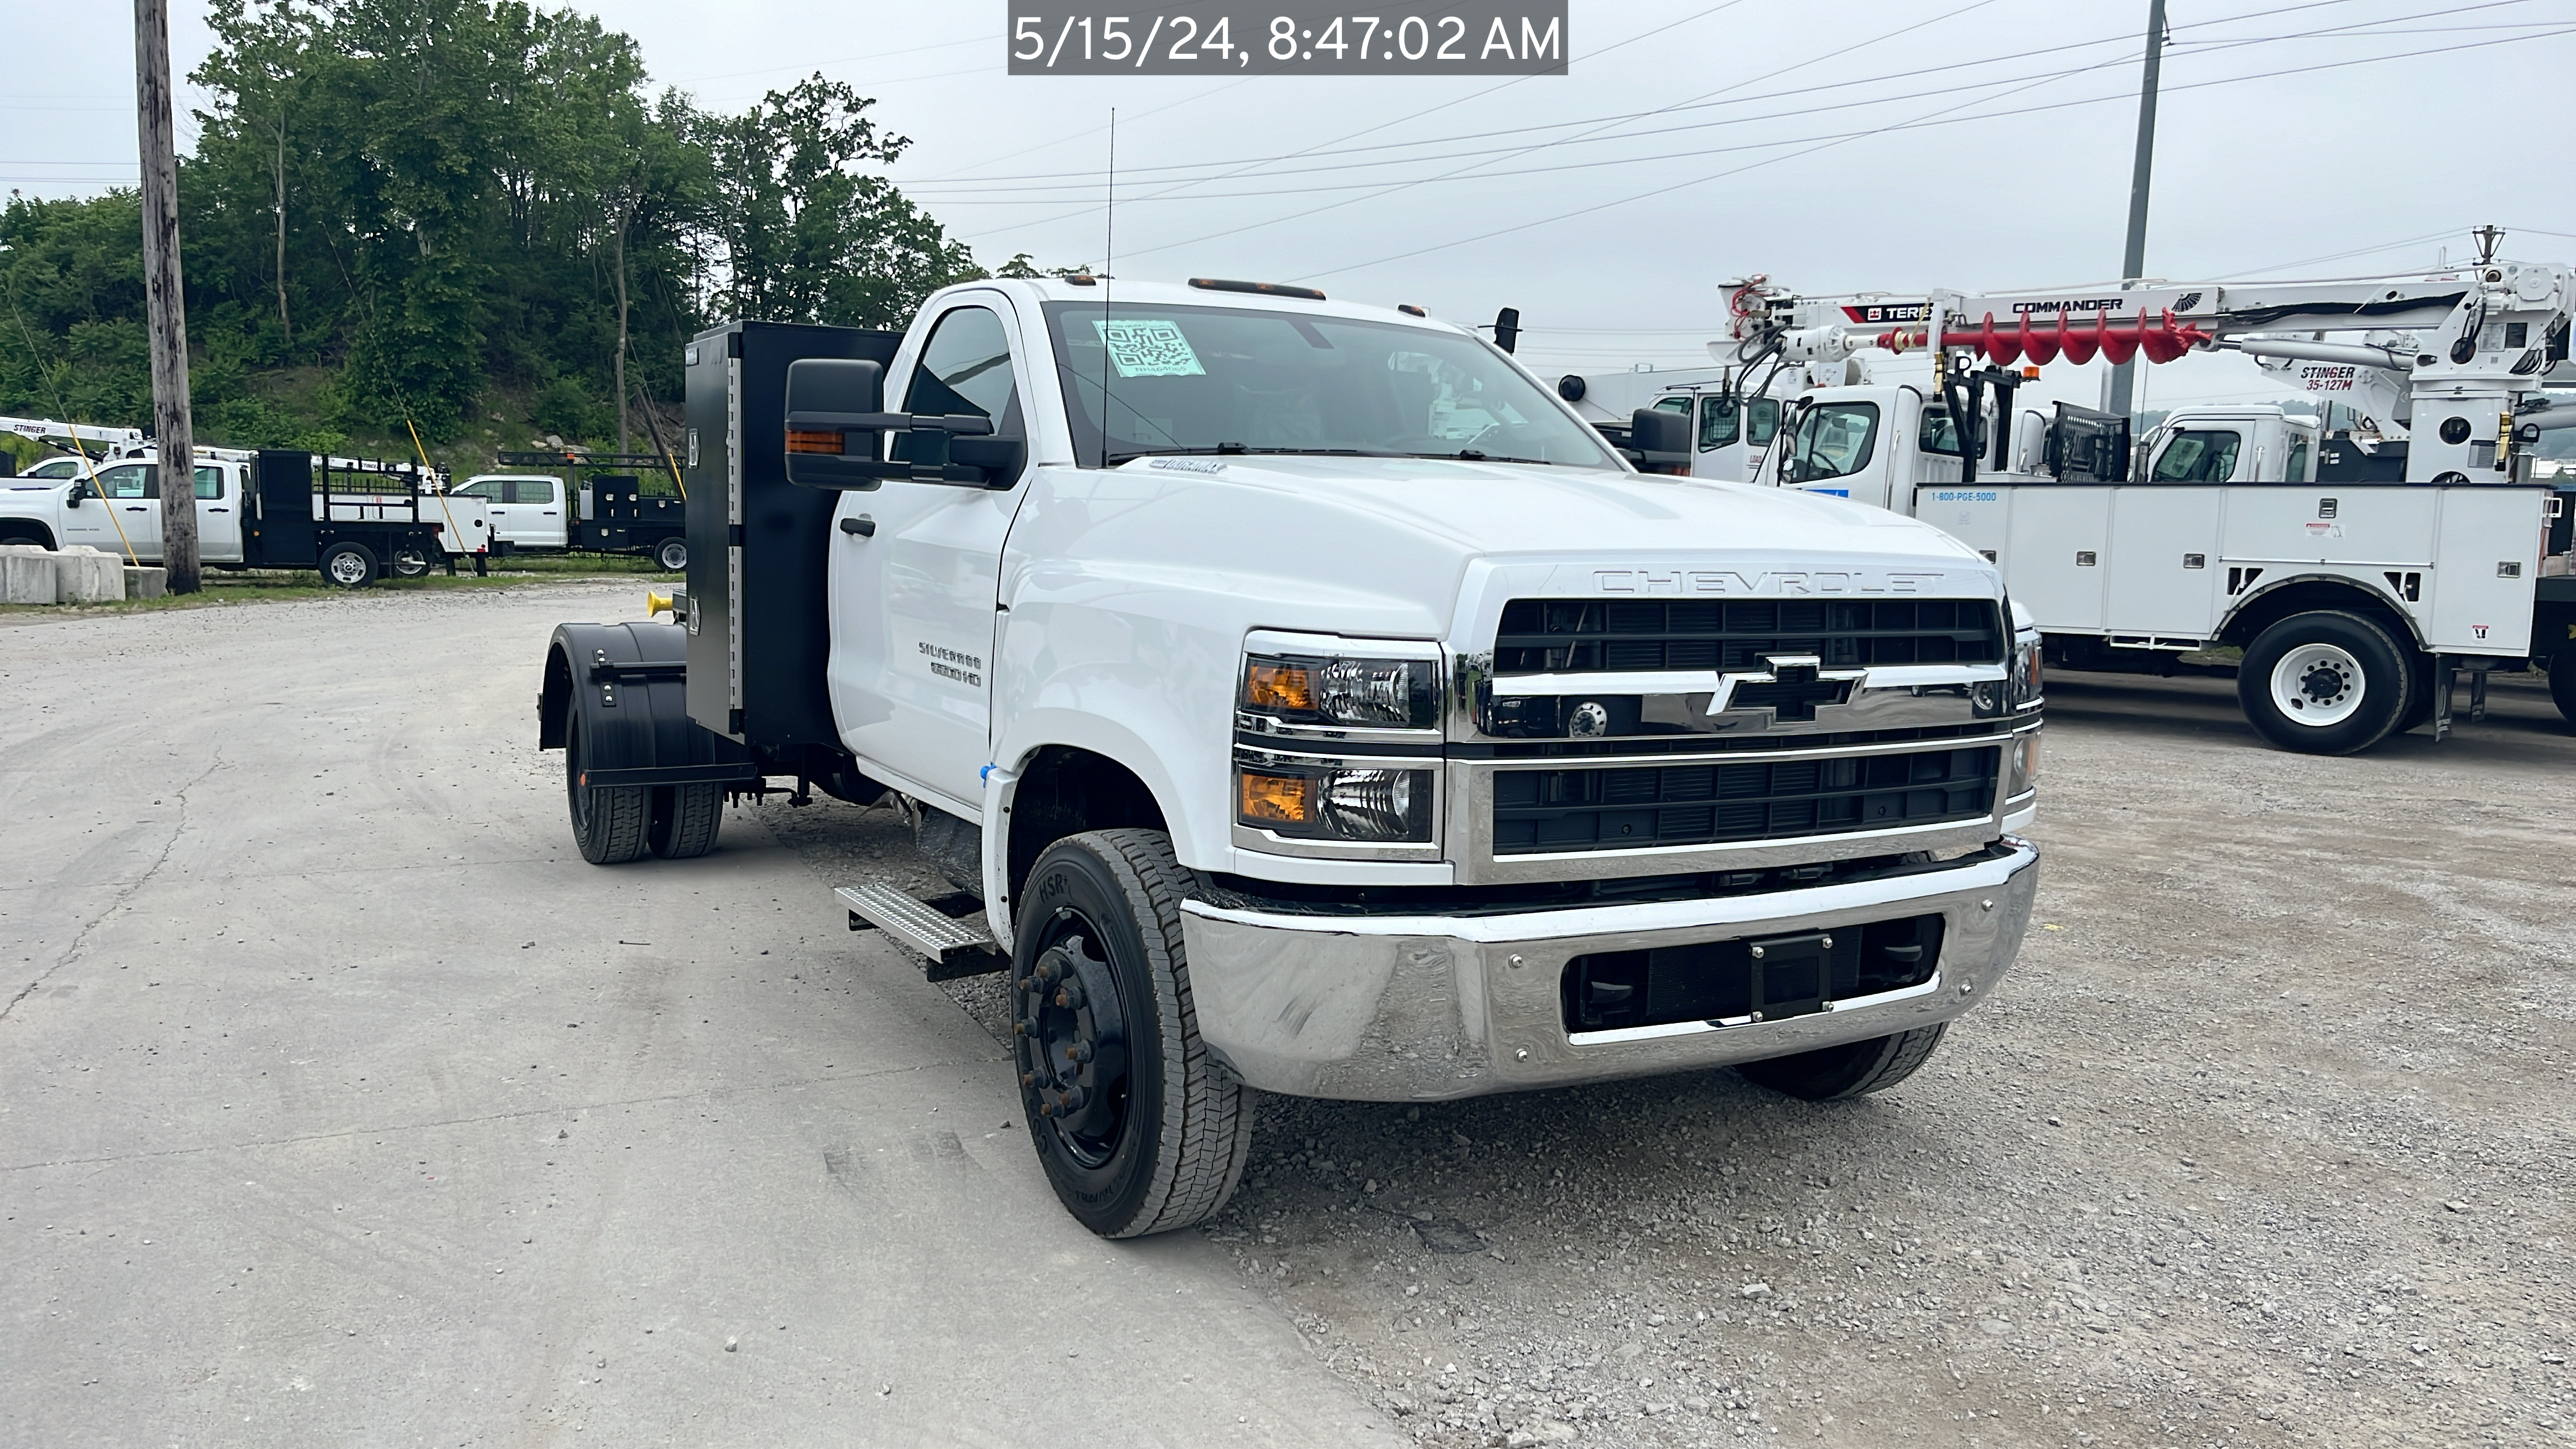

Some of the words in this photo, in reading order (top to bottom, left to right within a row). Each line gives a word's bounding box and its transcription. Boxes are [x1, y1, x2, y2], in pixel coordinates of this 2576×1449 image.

[2012, 298, 2123, 313] COMMANDER
[1886, 307, 1933, 319] TERE
[2300, 367, 2356, 378] STINGER
[2307, 379, 2352, 390] 35-127M
[14, 424, 46, 433] STINGER
[1933, 492, 1996, 501] 1-800-PGE-5000
[1593, 571, 1944, 594] CHEVROLET
[919, 642, 981, 670] SILVERADO
